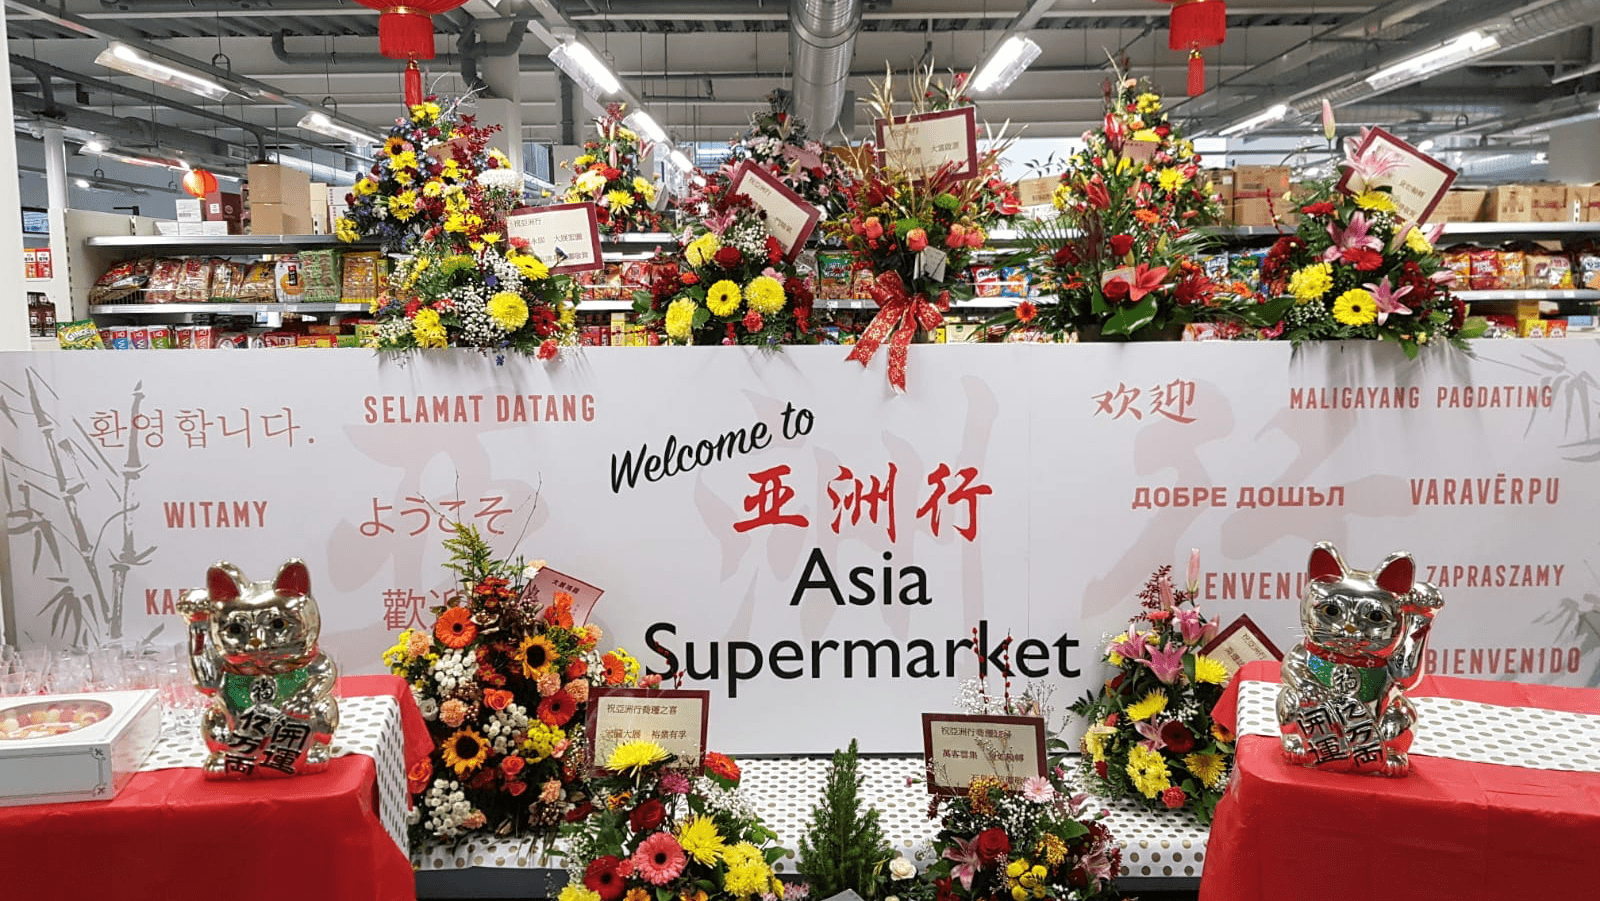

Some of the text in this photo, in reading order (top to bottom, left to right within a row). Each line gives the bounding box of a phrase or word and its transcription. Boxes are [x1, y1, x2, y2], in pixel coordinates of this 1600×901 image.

[364, 394, 595, 423] SELAMAT DATANG
[1091, 378, 1198, 424] 欢迎
[1290, 384, 1553, 409] MALIGAYANG PAGDATING
[89, 408, 316, 448] 환영합니다.
[610, 401, 815, 494] Welcome to
[733, 462, 993, 544] 亚洲行
[1131, 486, 1346, 510] ДОБРЕ ДОШЪЛ
[1410, 473, 1560, 506] VARAVĒRPU
[163, 501, 268, 528] WITAMY
[360, 496, 513, 537] ようこそ
[790, 547, 932, 606] Asia
[1426, 564, 1565, 588] ZAPRASZAMY
[644, 620, 1082, 698] Supermarket
[1424, 646, 1582, 675] BIENVENIDO
